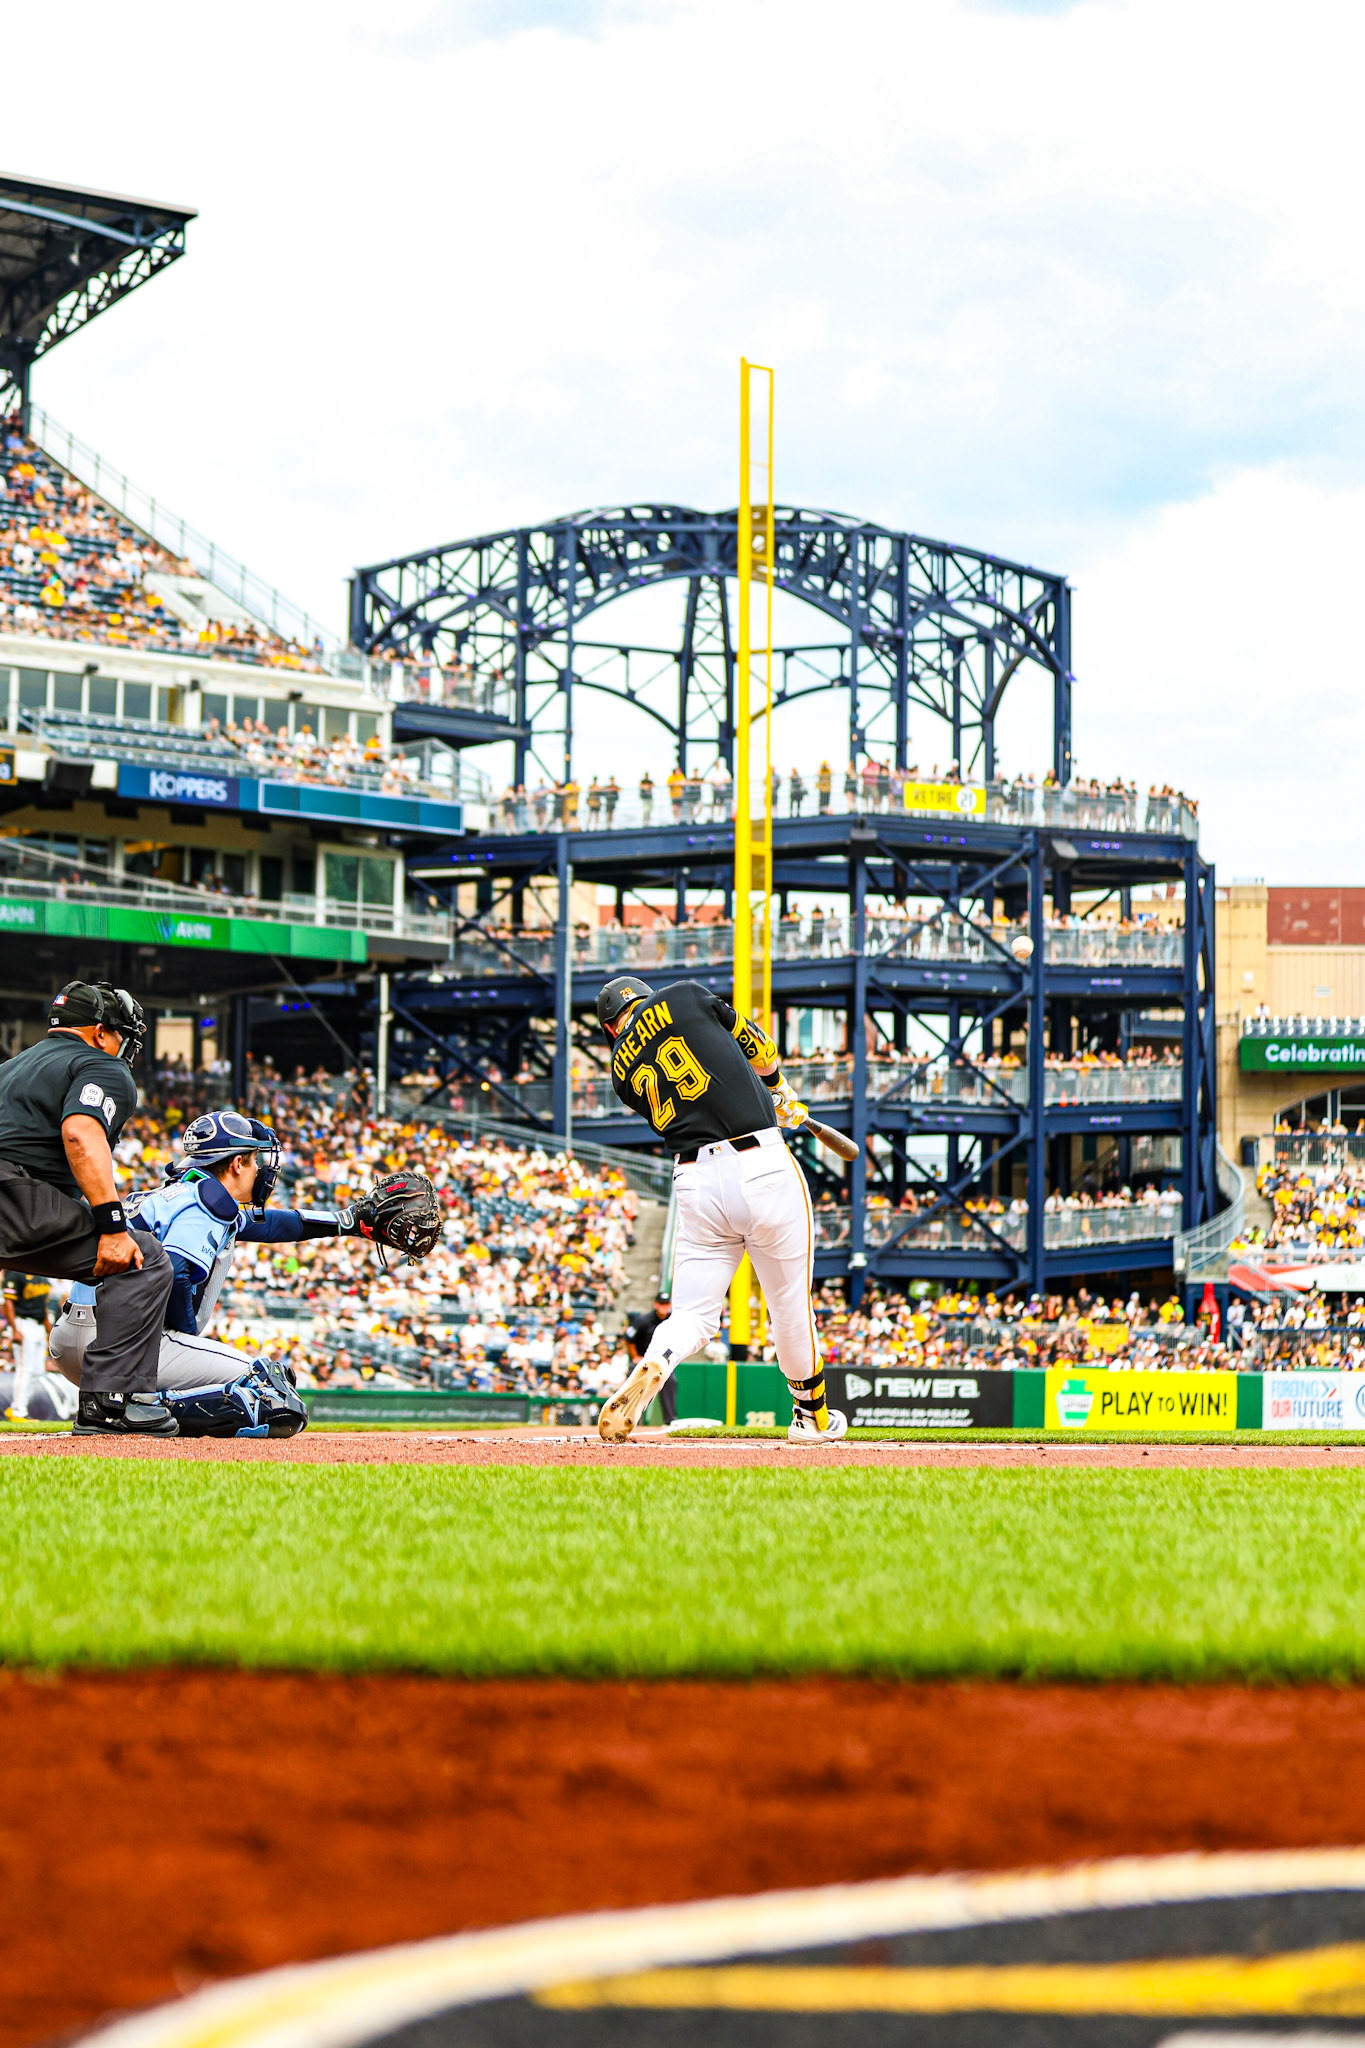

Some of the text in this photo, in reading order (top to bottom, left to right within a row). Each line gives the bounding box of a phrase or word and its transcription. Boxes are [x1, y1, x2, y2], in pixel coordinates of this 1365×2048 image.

[149, 770, 228, 802] KOPPERS
[613, 1000, 674, 1082] O'HEARN
[79, 1083, 117, 1126] 80
[630, 1035, 712, 1131] 29
[1101, 1391, 1228, 1416] PLAY TO WIN!
